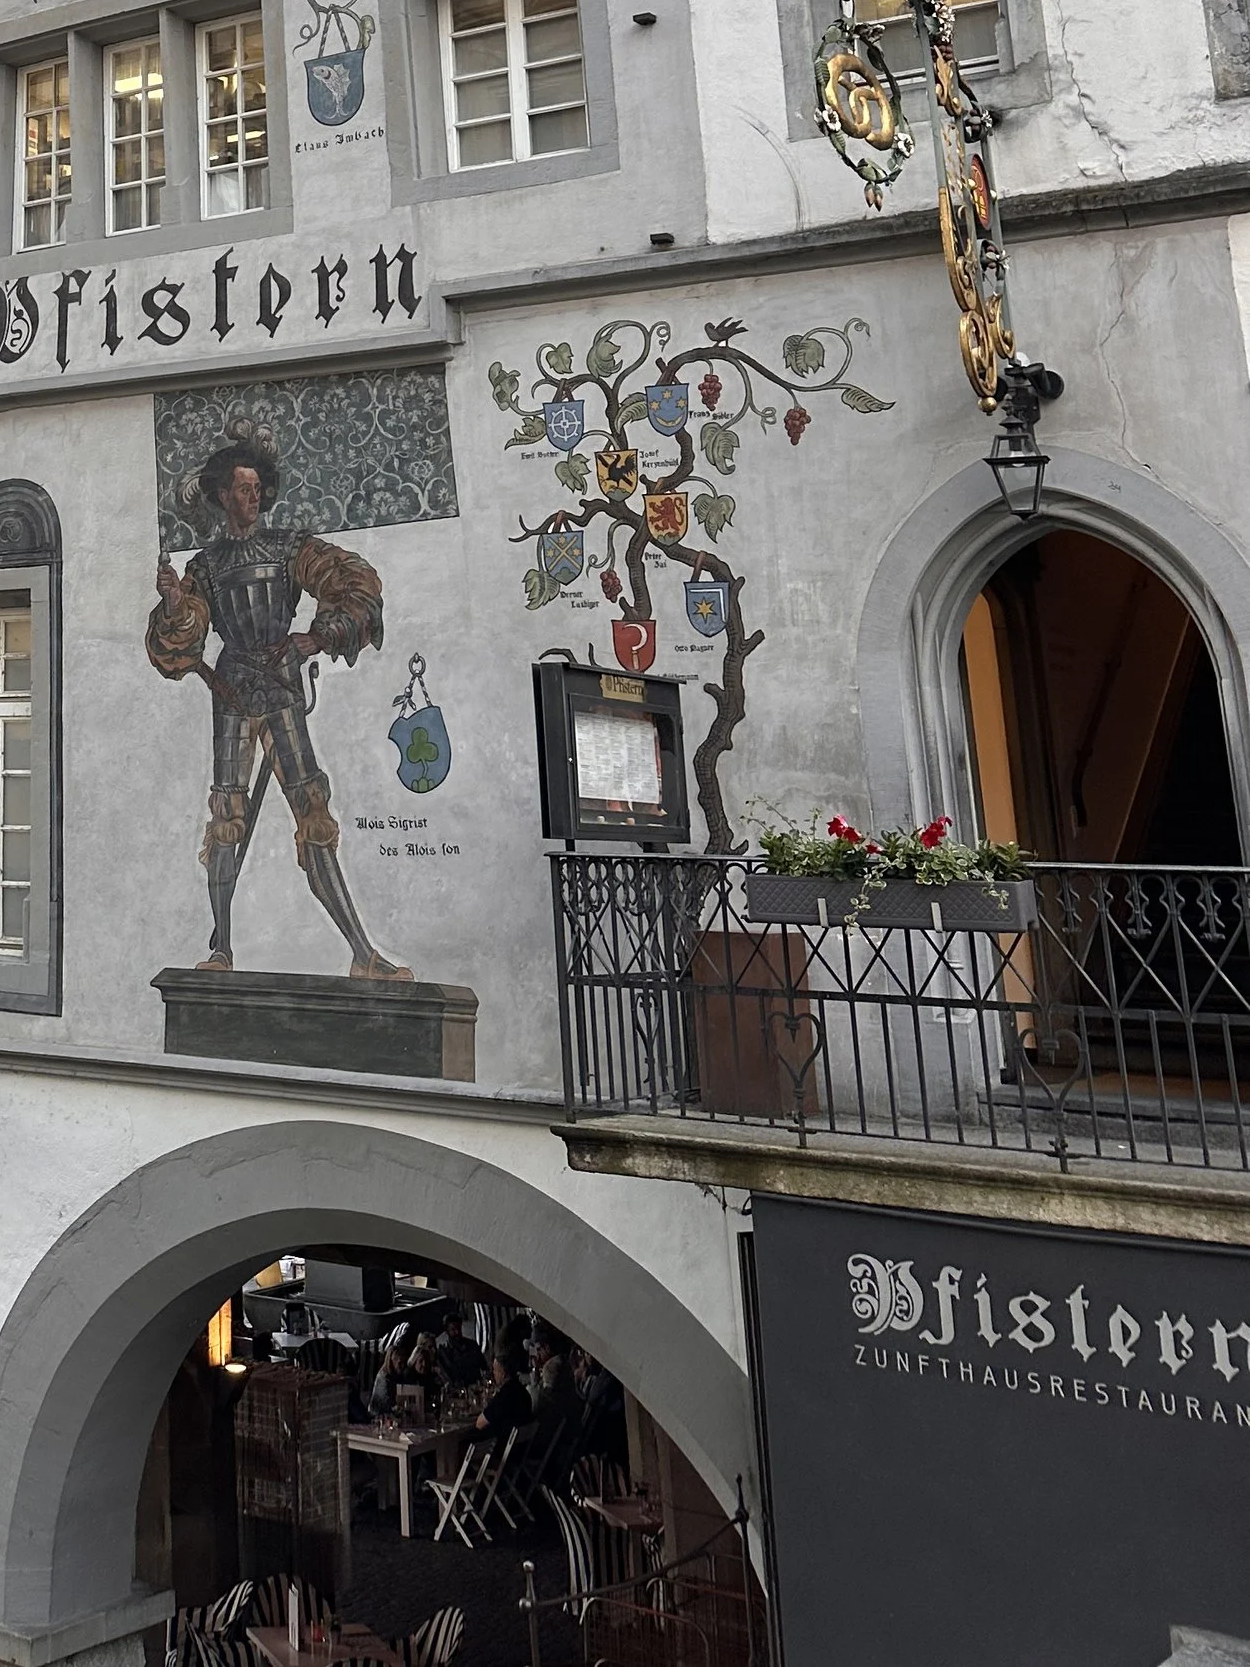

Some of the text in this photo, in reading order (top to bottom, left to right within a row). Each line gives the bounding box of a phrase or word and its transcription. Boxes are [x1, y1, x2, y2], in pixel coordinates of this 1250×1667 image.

[355, 816, 428, 831] Alois Sigrist
[380, 844, 399, 856] des
[405, 843, 436, 856] Alois
[847, 1253, 1250, 1383] Pfistern
[854, 1344, 1250, 1426] ZUNFTHAUSRESTAURAN
